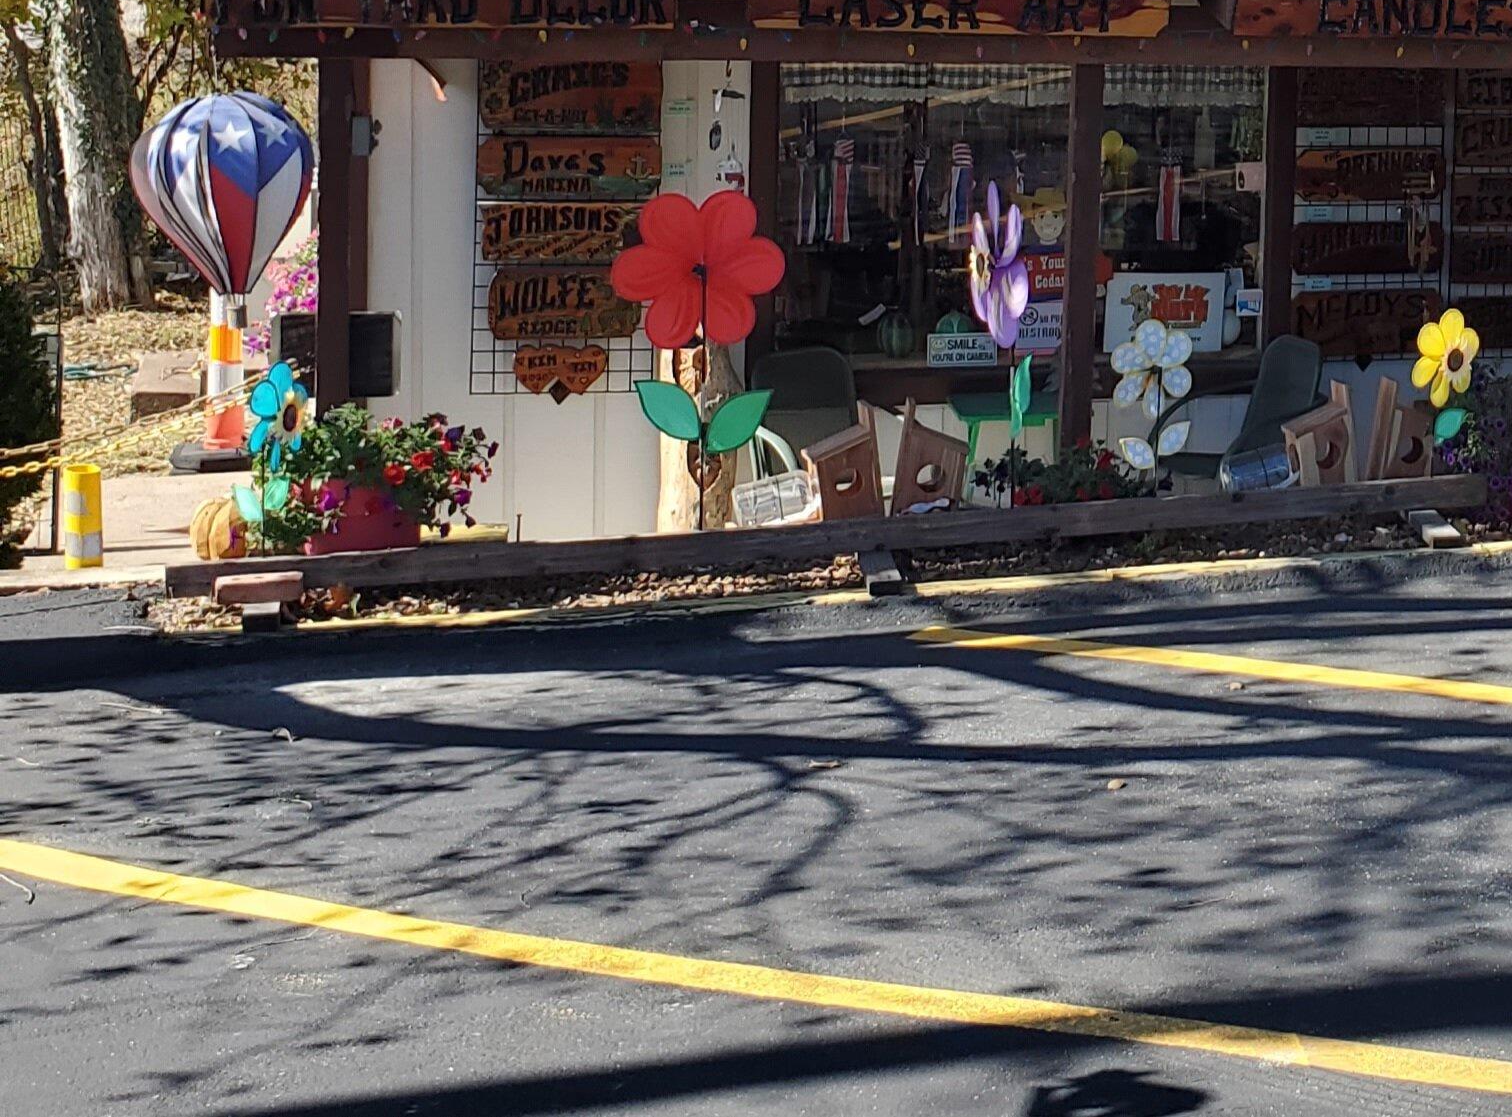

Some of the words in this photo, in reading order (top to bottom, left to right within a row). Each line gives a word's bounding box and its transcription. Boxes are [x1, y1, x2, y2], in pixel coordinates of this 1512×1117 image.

[521, 177, 592, 193] MARINA
[497, 275, 595, 321] WOLFE
[518, 319, 578, 335] RIDGE
[947, 338, 978, 350] SMILE
[931, 351, 955, 362] YOU'RE
[955, 351, 966, 361] ON
[966, 350, 994, 361] CAMERA
